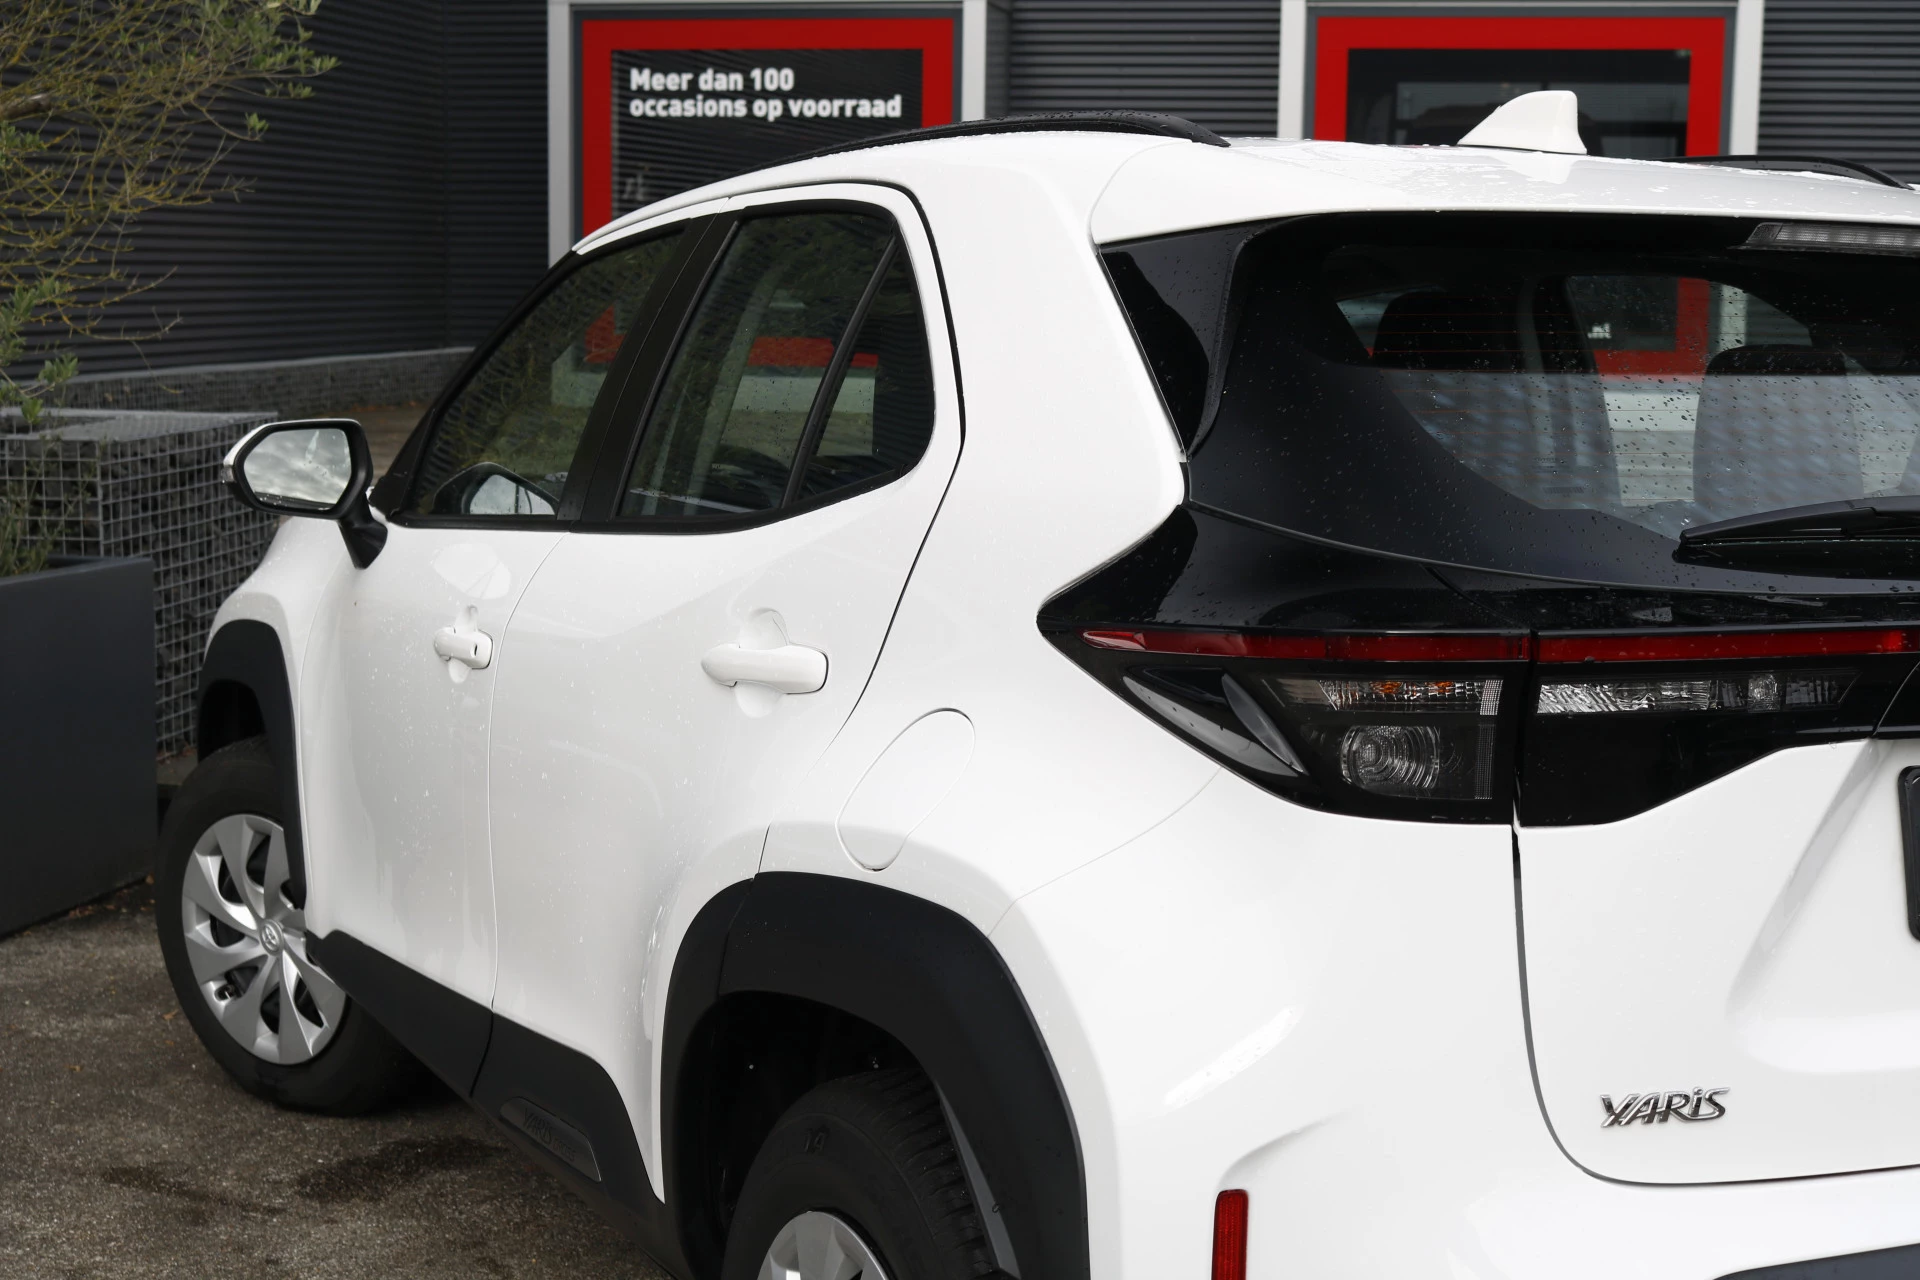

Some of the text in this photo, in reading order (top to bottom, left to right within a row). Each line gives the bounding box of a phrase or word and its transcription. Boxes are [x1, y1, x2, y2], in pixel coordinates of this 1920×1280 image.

[629, 67, 795, 92] Meer dan 100
[629, 93, 902, 122] occasions op voorraad
